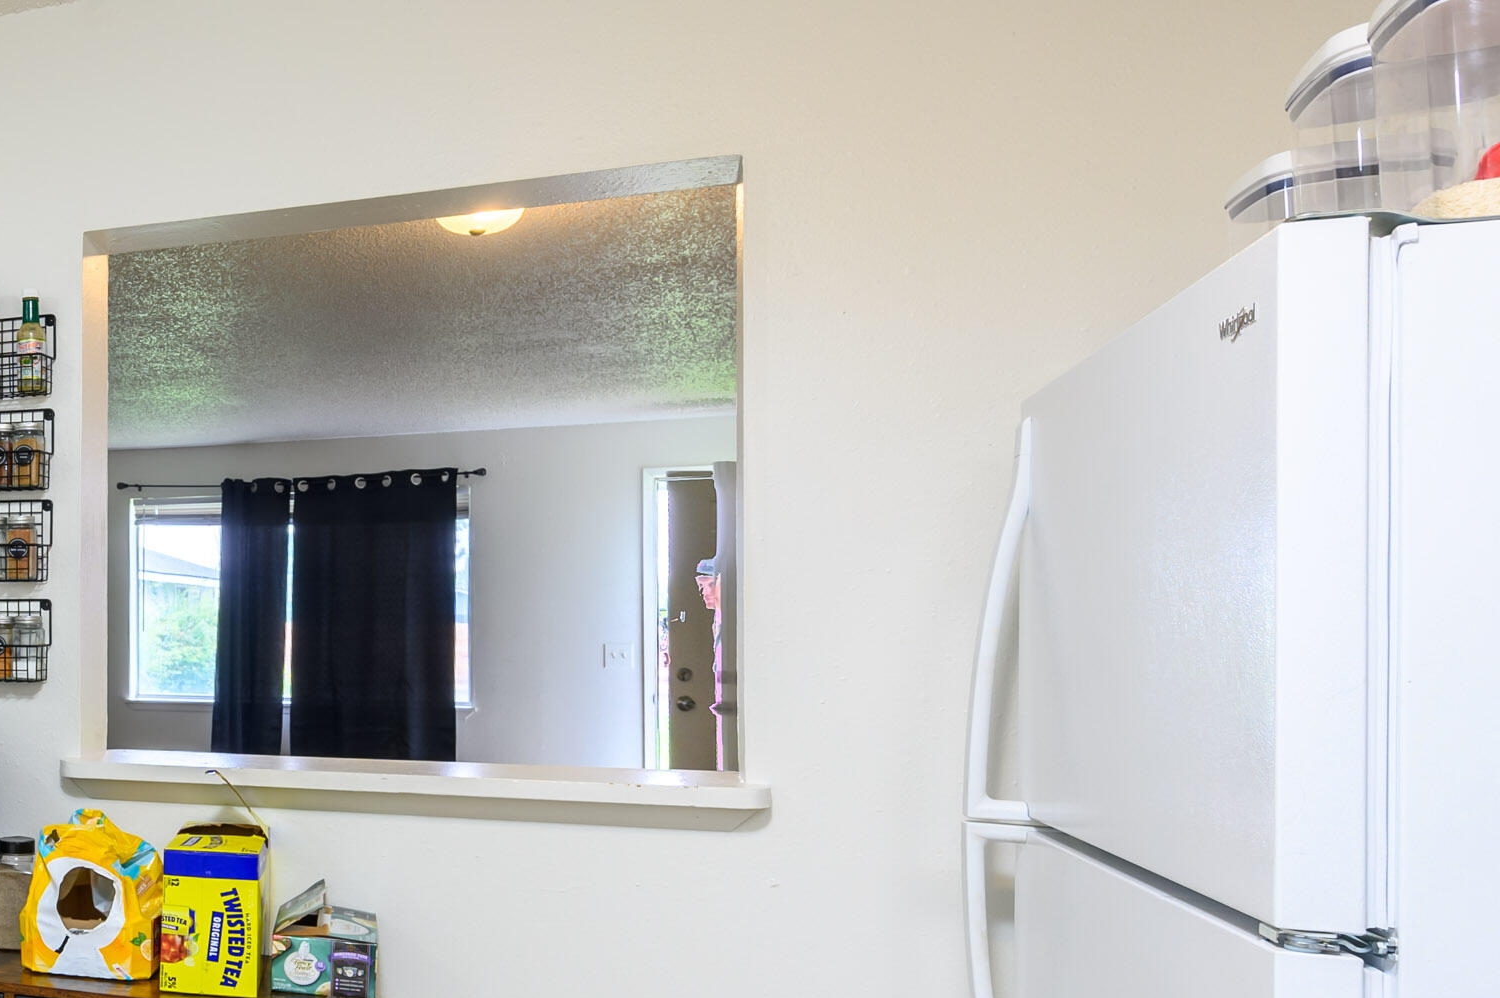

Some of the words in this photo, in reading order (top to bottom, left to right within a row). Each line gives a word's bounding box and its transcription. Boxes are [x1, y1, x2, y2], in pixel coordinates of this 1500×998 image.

[171, 878, 179, 886] 12
[162, 915, 175, 923] STED
[176, 917, 187, 926] TEA
[220, 887, 245, 957] TWISTED
[209, 916, 221, 957] ORIGINAL
[168, 976, 177, 989] 5%
[220, 960, 243, 987] TEA
